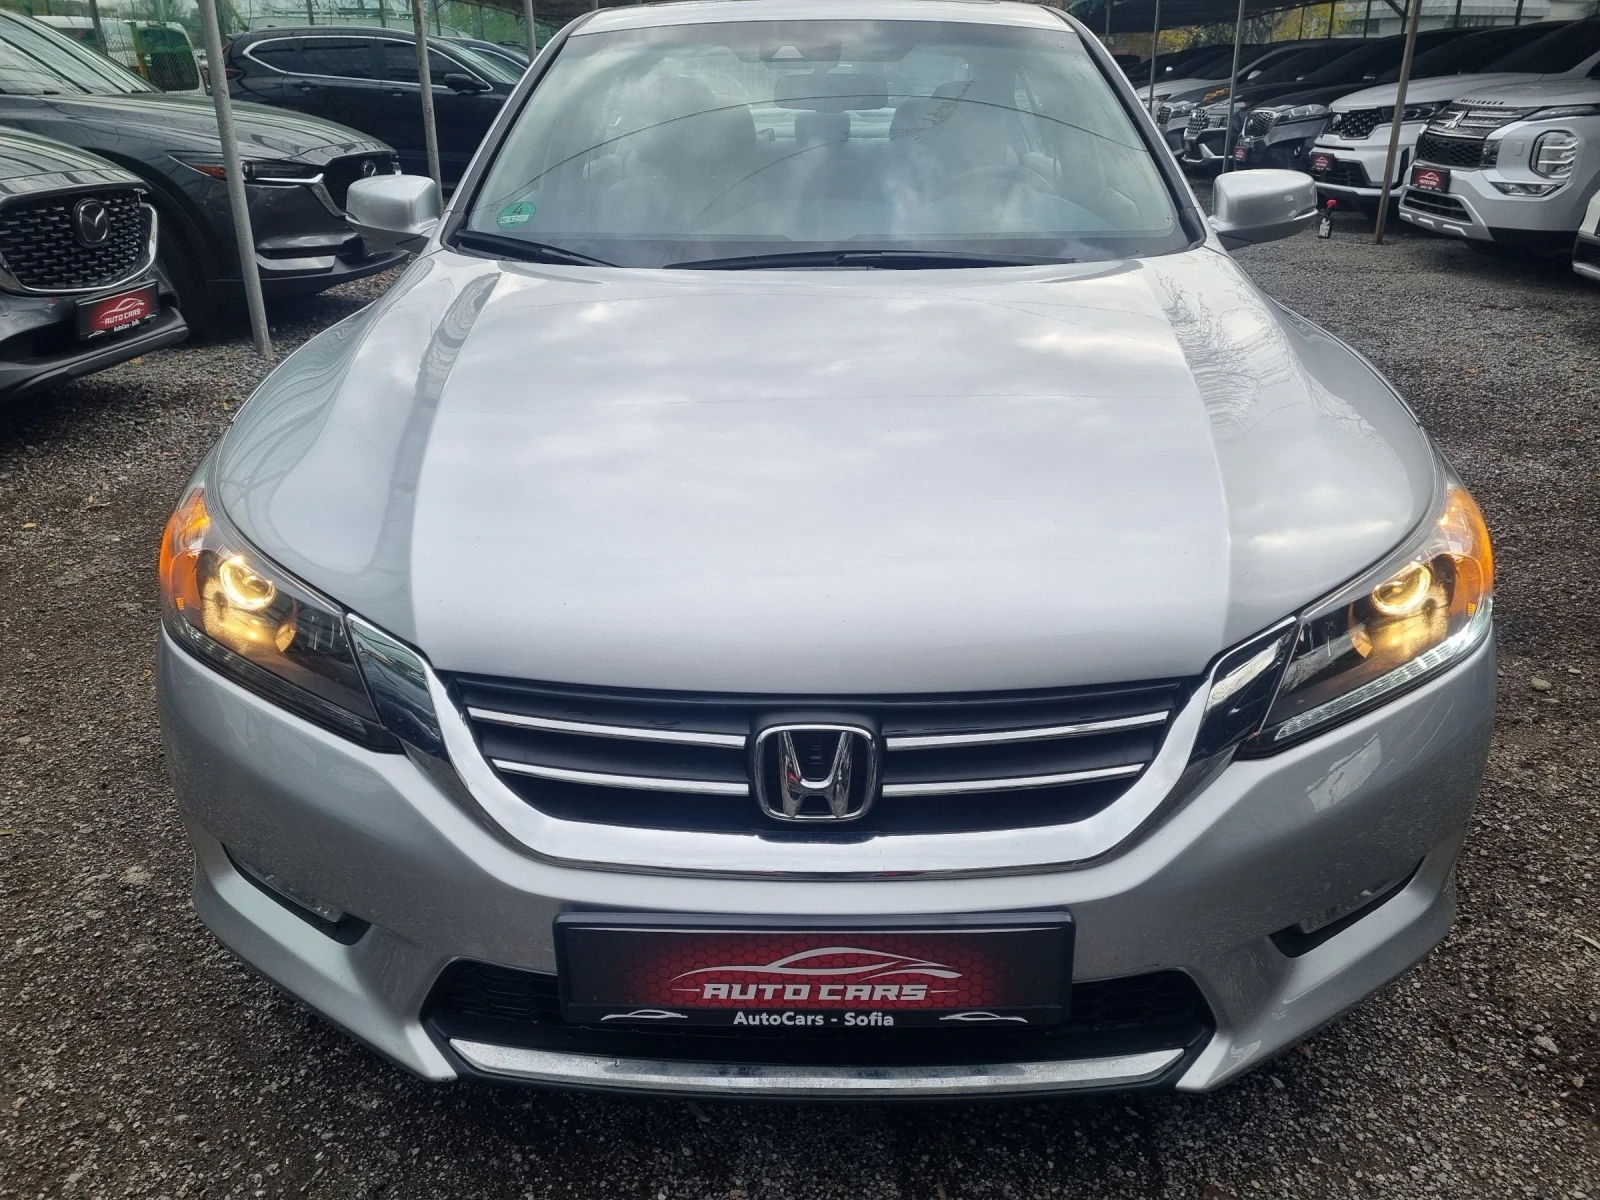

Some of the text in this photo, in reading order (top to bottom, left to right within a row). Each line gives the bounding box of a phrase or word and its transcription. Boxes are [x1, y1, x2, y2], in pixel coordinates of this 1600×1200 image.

[512, 202, 524, 215] 4
[105, 308, 140, 325] AUTO CARS
[703, 983, 928, 1000] AUTO CARS
[733, 1011, 824, 1025] AutoCars
[844, 1012, 894, 1026] Sofia
